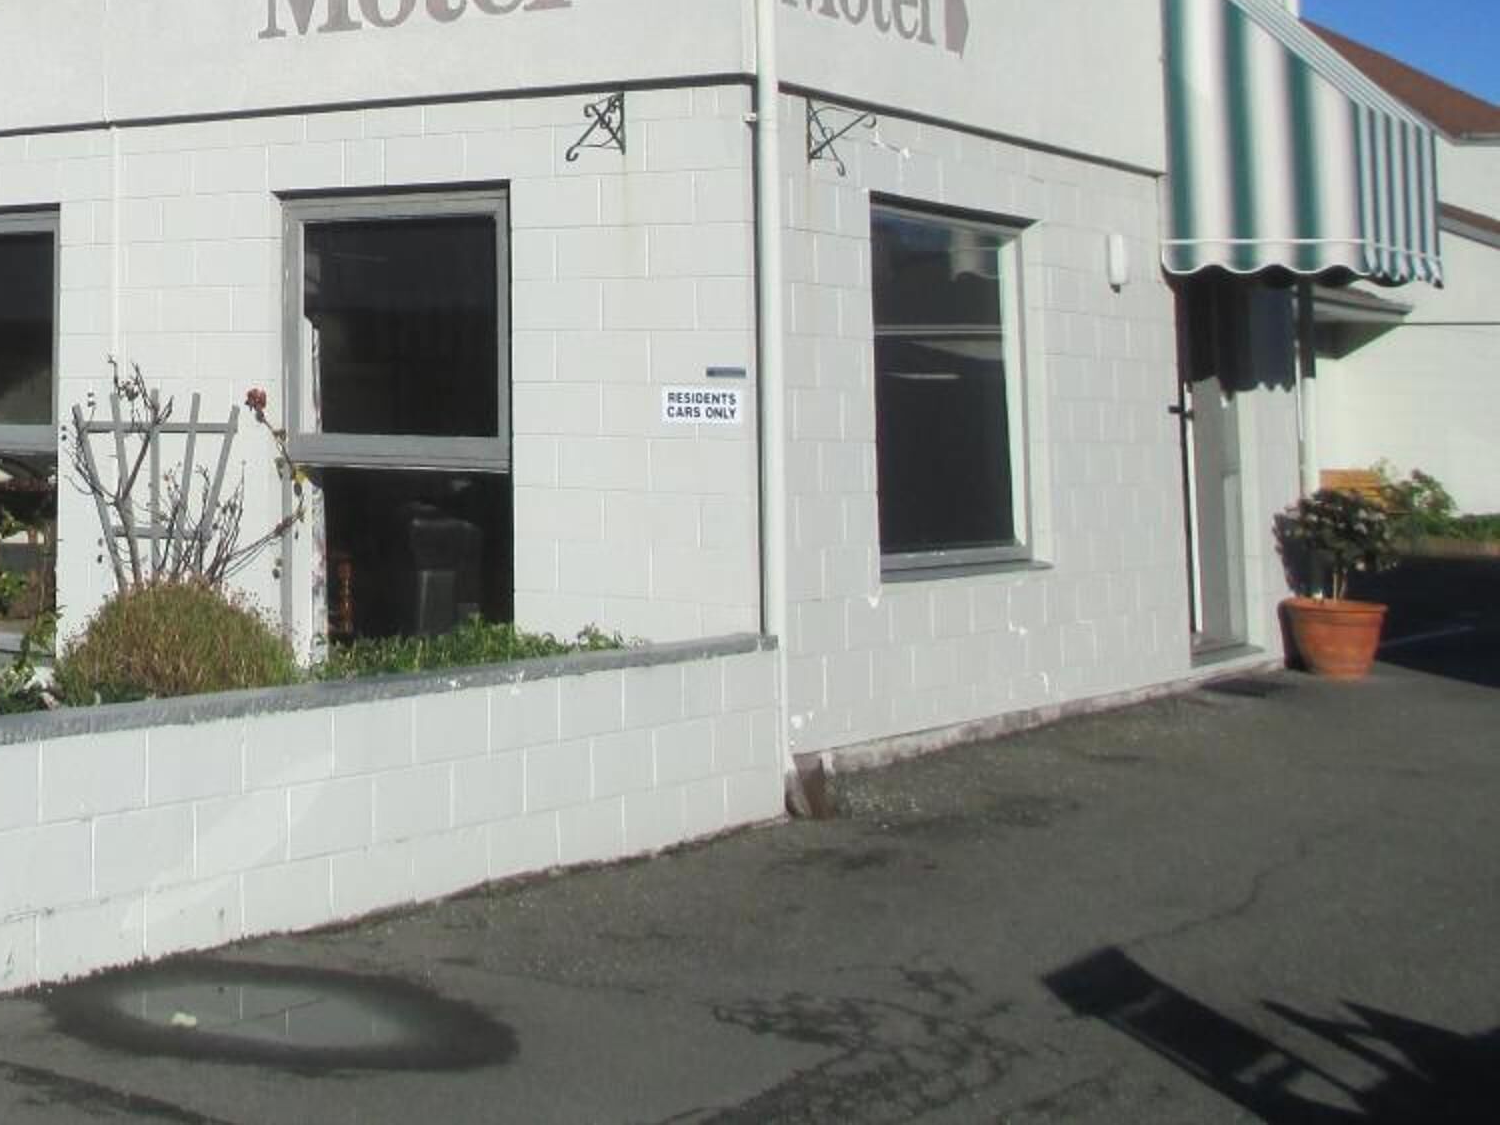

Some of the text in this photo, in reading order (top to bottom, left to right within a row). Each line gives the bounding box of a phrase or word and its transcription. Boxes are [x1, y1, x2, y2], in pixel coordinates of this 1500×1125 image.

[667, 392, 737, 405] RESIDENTS
[667, 406, 737, 419] CARS ONLY
